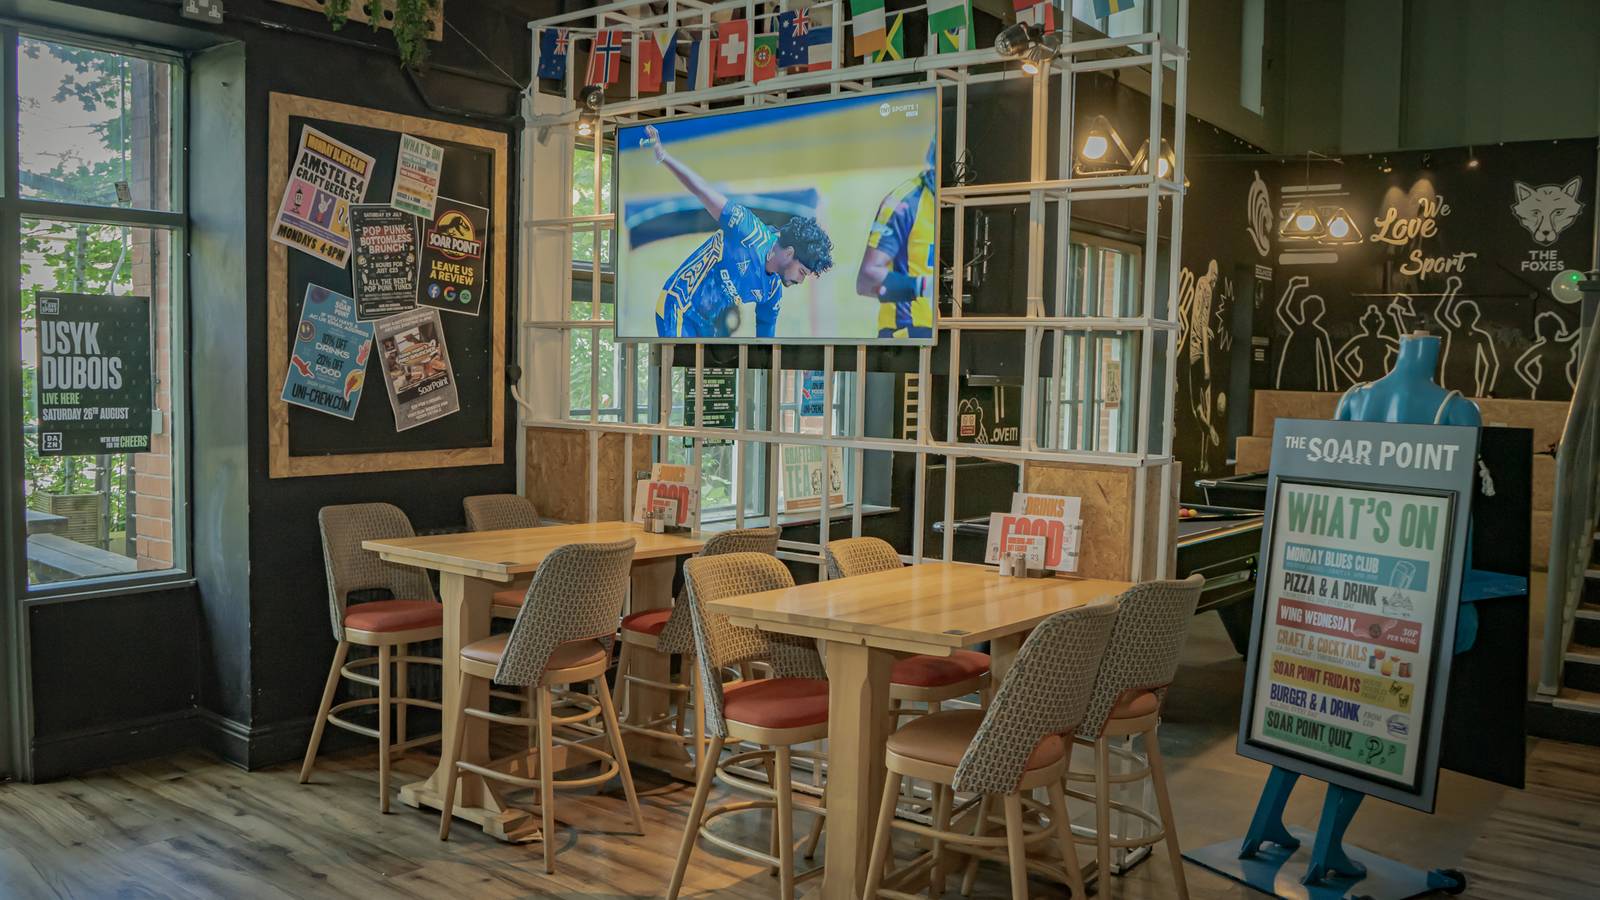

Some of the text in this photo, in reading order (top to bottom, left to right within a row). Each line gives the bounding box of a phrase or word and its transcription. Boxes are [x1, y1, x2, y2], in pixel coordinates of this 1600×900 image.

[296, 167, 324, 188] CRAFT
[324, 179, 349, 200] BEERS
[300, 152, 364, 194] AMSTEL £4
[1418, 195, 1451, 218] We
[277, 224, 317, 249] MONDAYS
[360, 234, 412, 246] BOTTOMLESS
[362, 224, 407, 236] POP PUNK
[1370, 208, 1438, 245] Love
[369, 243, 405, 254] BRUNCH
[430, 232, 480, 255] SOAR POINT
[1528, 250, 1558, 260] THE
[430, 270, 474, 286] A REVIEW
[432, 260, 474, 277] LEAVE US
[1400, 249, 1478, 280] Sport
[1521, 260, 1565, 272] FOXES
[41, 320, 100, 355] USYK
[315, 343, 350, 359] DRINKS
[42, 356, 122, 389] DUBOIS
[315, 364, 341, 378] FOOD
[42, 392, 80, 405] LIVE HERE
[292, 384, 351, 412] UNI-CREW.COM
[42, 407, 129, 420] SATURDAY 26TH AUGUST
[120, 435, 148, 448] CHEERS
[1285, 436, 1459, 472] THE SOAR POINT
[1288, 491, 1439, 550] WHAT'S ON
[1286, 545, 1323, 565] MONDAY
[1324, 552, 1352, 571] BLUES
[1354, 555, 1380, 574] CLUB
[1283, 572, 1378, 607] PIZZA & A DRINK
[1280, 605, 1356, 633] WING WEDNESDAY
[1277, 629, 1305, 648] CRAFT
[1308, 636, 1314, 650] &
[1317, 636, 1368, 662] COCKTAILS
[1273, 660, 1295, 677] SOAR
[1296, 666, 1322, 683] POINT
[1322, 670, 1361, 693] FRIDAYS
[1270, 683, 1361, 722] BURGER & A DRINK
[1267, 711, 1293, 734] SOAR
[1296, 718, 1325, 742] POINT
[1328, 728, 1353, 750] QUIZ
